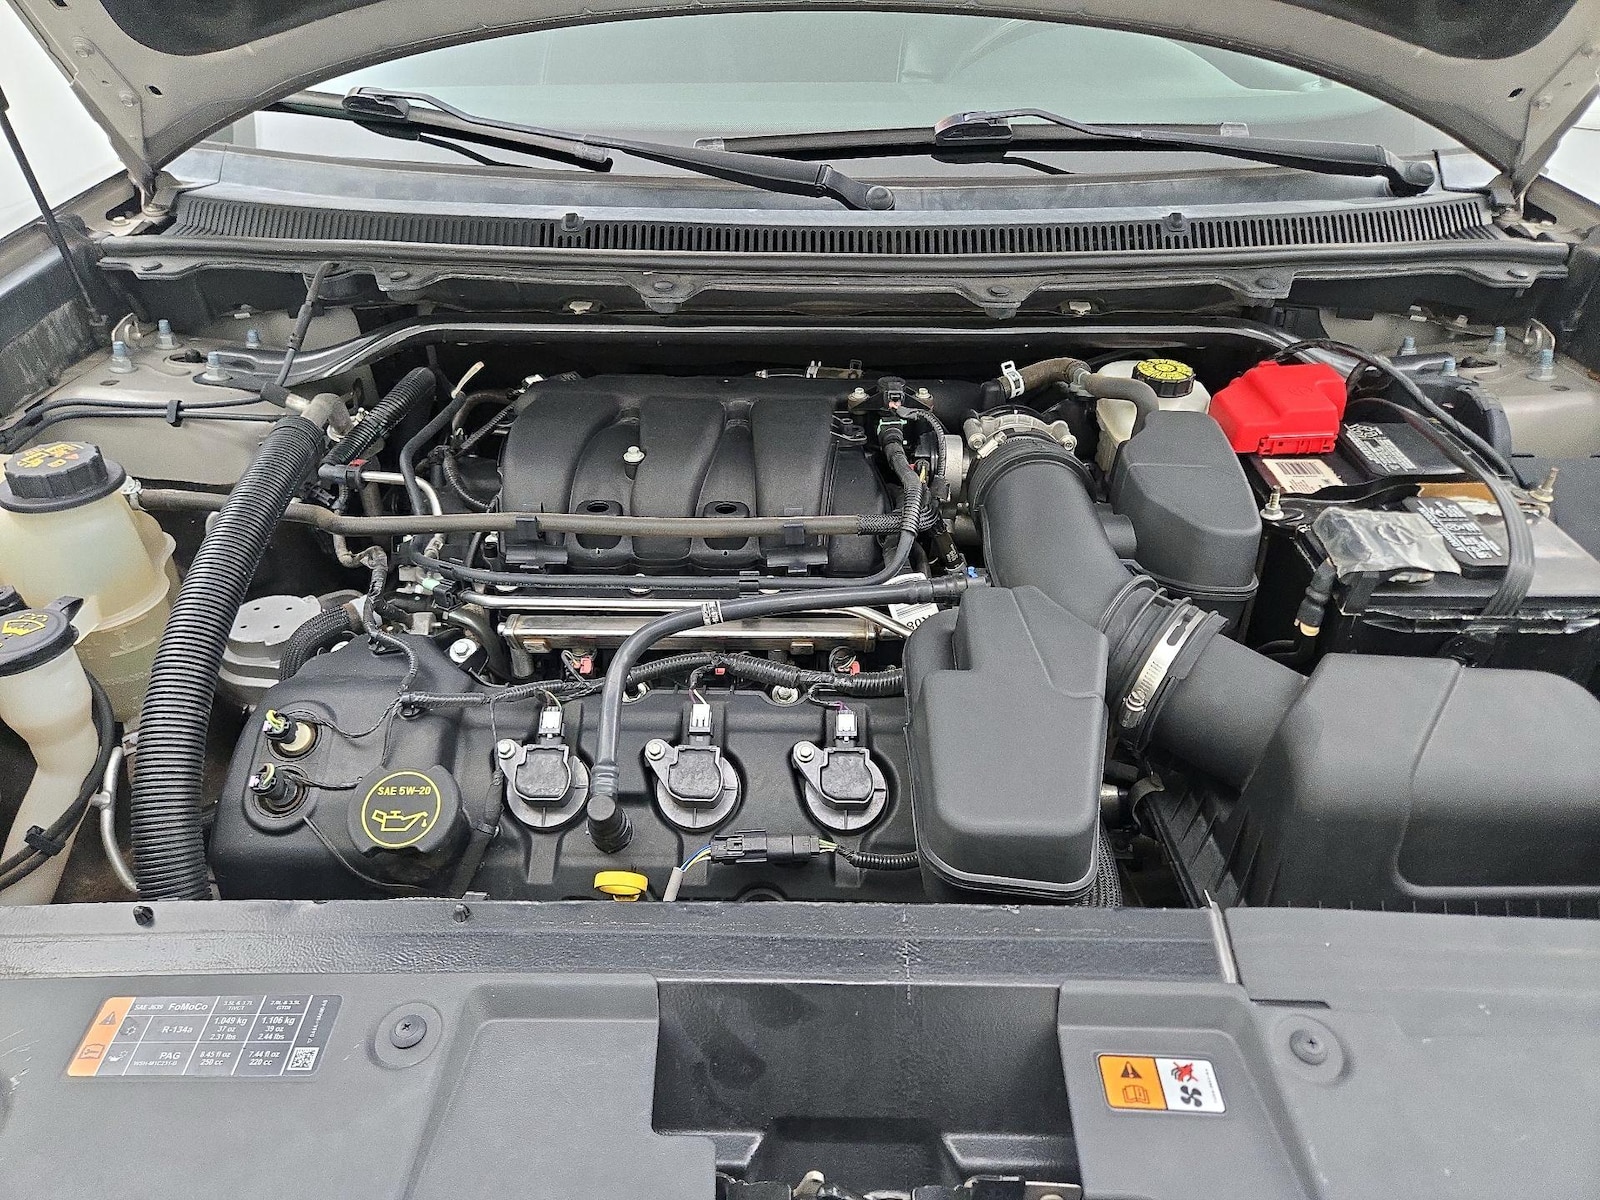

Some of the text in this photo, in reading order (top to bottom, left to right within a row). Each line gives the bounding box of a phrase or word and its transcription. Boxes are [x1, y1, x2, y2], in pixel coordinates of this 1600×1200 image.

[377, 786, 432, 796] SAE 5W-20
[167, 1003, 208, 1011] FoMoCo
[236, 1017, 248, 1026] kg
[262, 1016, 296, 1026] 1.106 kg
[159, 1052, 181, 1060] PAG
